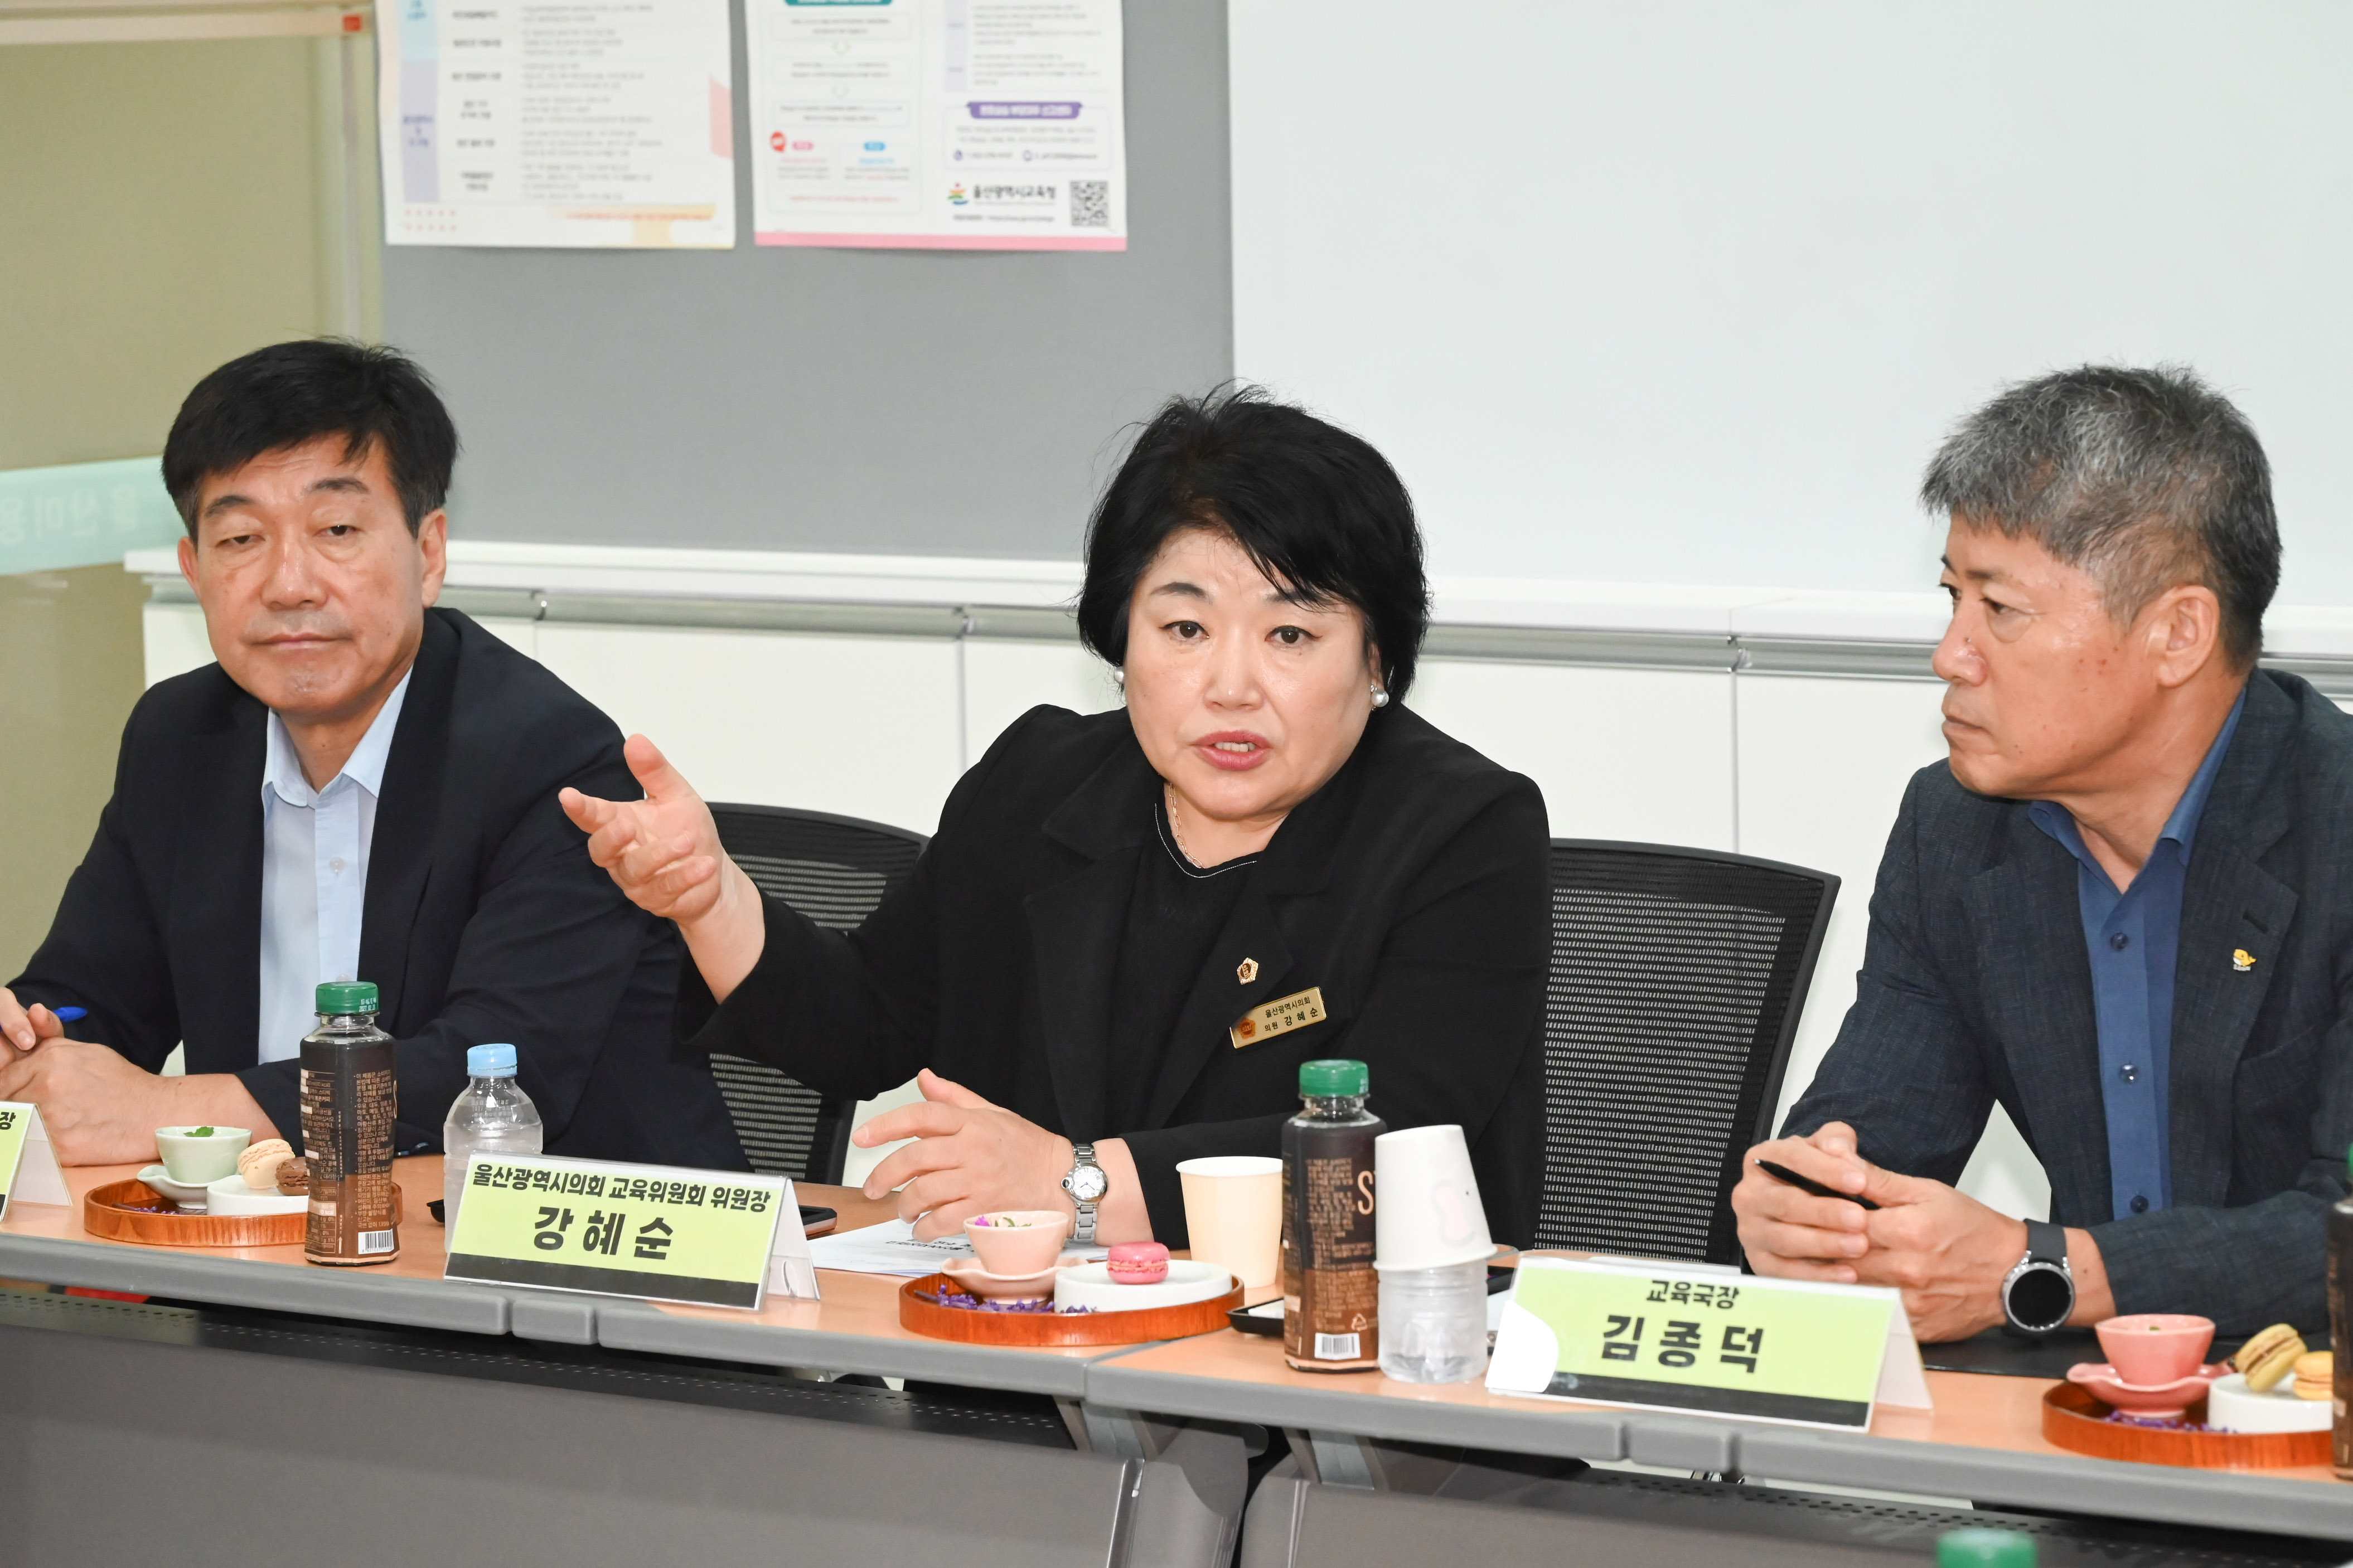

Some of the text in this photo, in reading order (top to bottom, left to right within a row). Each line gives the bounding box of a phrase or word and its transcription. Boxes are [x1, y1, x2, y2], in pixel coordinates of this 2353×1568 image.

[974, 185, 1057, 200] 울산광역시교육청
[1265, 996, 1310, 1018] 울산광역시의회
[1265, 1022, 1279, 1031] 의원
[473, 1164, 771, 1212] 울산광역시의회 교육위원회 위원장
[1646, 1280, 1740, 1309] 교육국장
